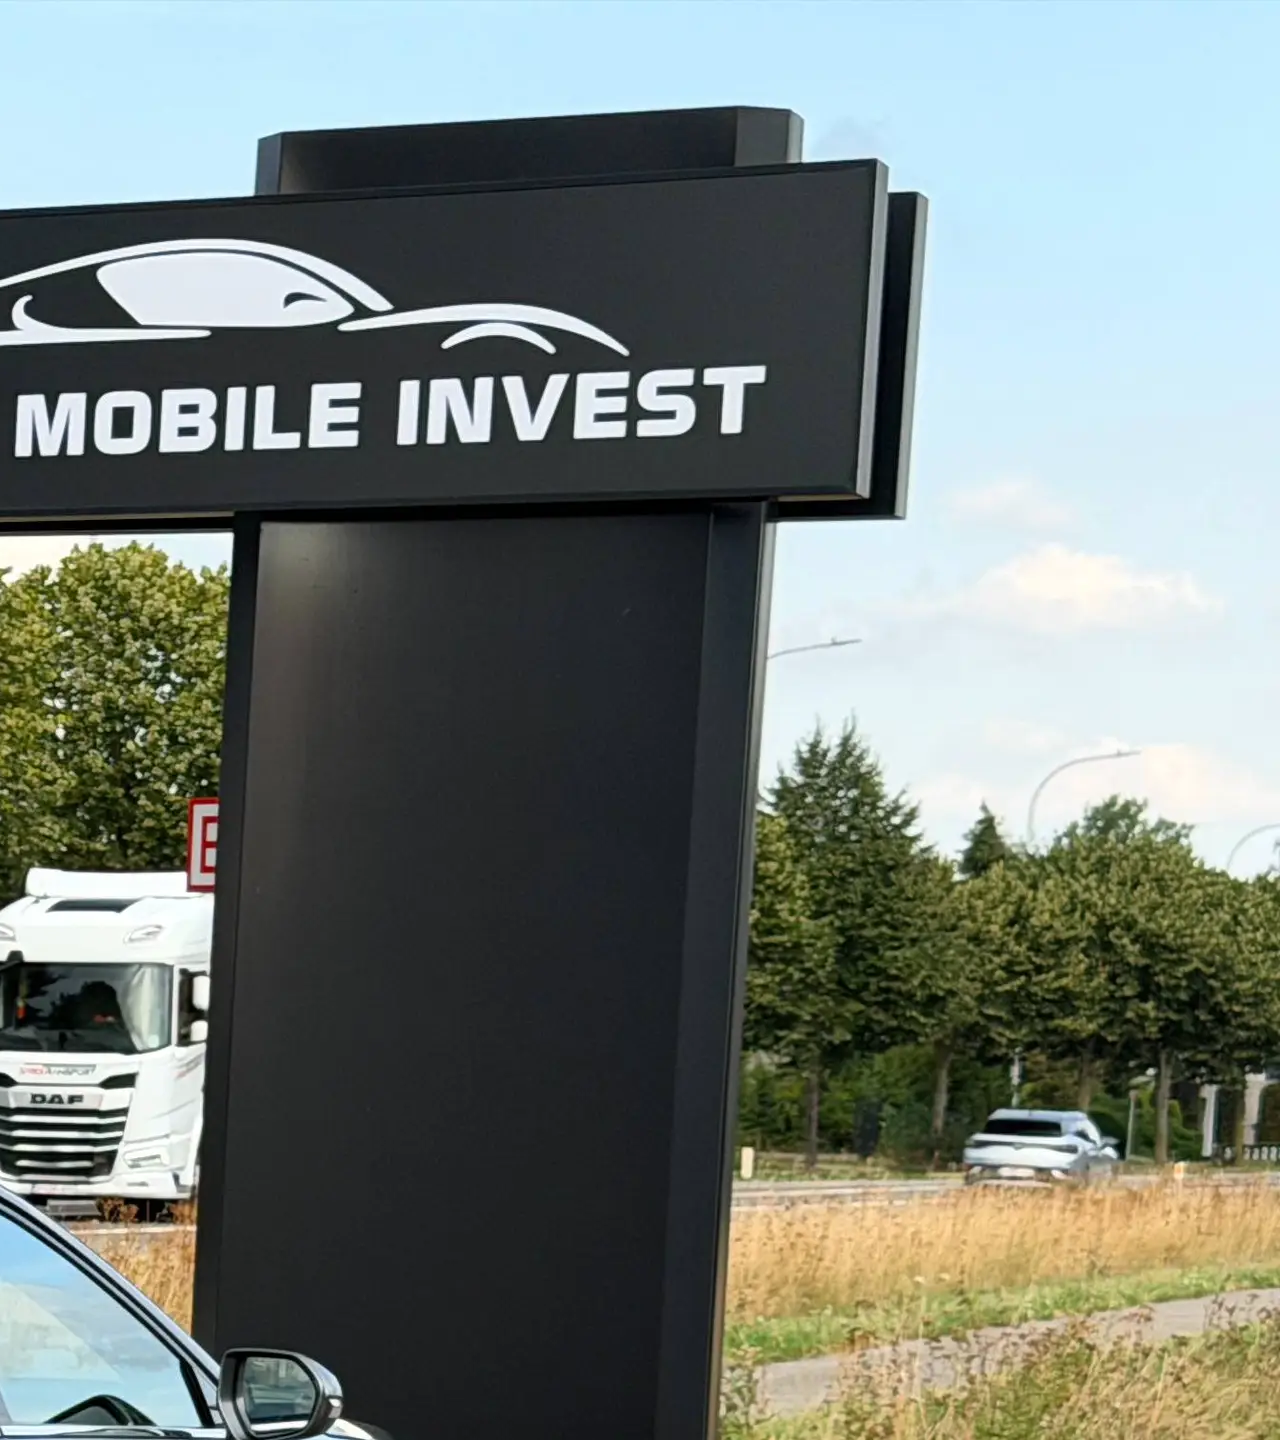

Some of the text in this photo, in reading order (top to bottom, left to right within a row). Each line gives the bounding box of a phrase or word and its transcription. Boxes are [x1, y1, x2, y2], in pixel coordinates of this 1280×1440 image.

[14, 382, 362, 457] MOBILE
[396, 365, 767, 446] INVEST
[30, 1093, 85, 1105] DAF
